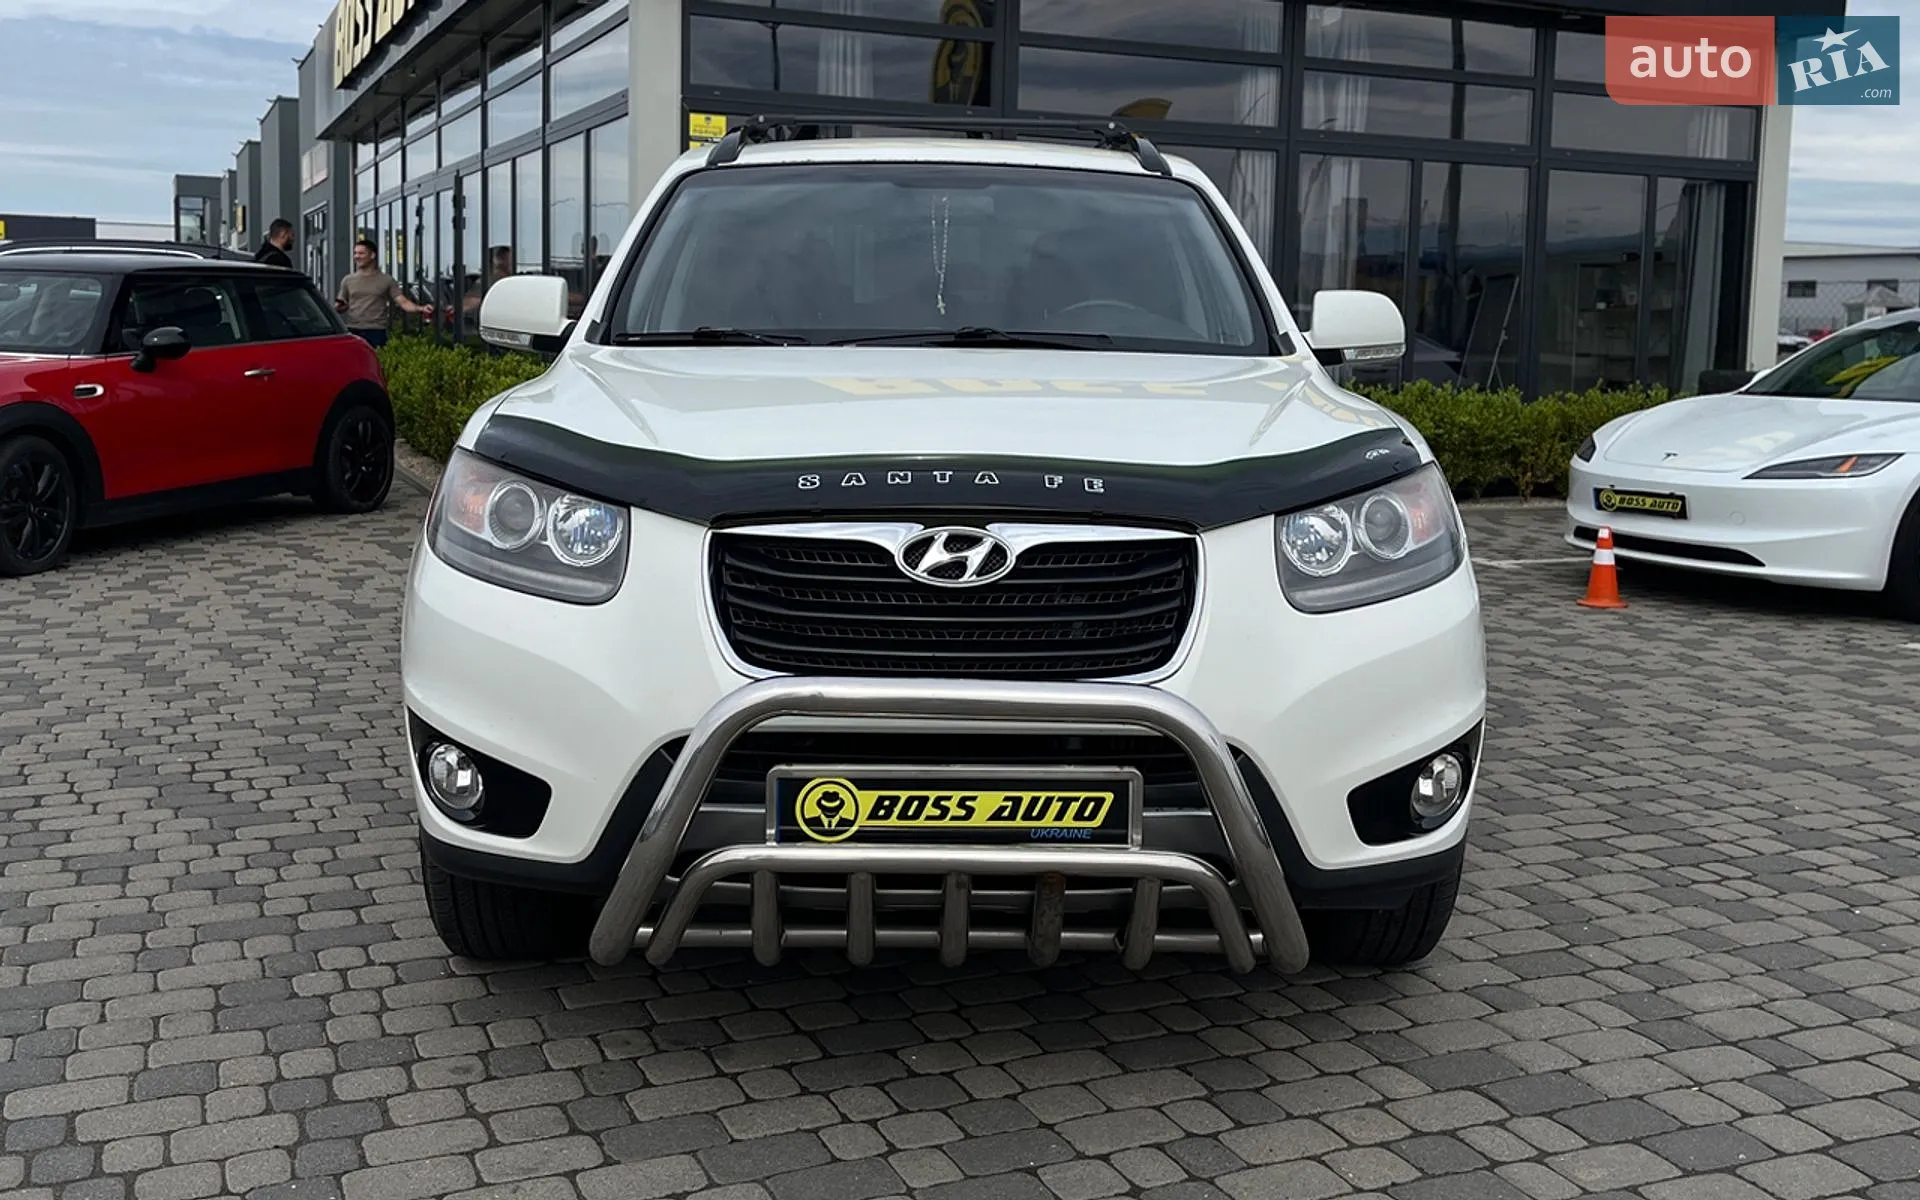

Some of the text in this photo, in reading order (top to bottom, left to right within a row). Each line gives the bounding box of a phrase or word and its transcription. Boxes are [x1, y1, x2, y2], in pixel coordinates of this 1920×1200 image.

[797, 470, 1106, 494] SANTA FE
[1617, 495, 1680, 510] BOSS AUTO
[866, 794, 1103, 822] BOSS AUTO
[1030, 828, 1094, 840] UKRAINE
